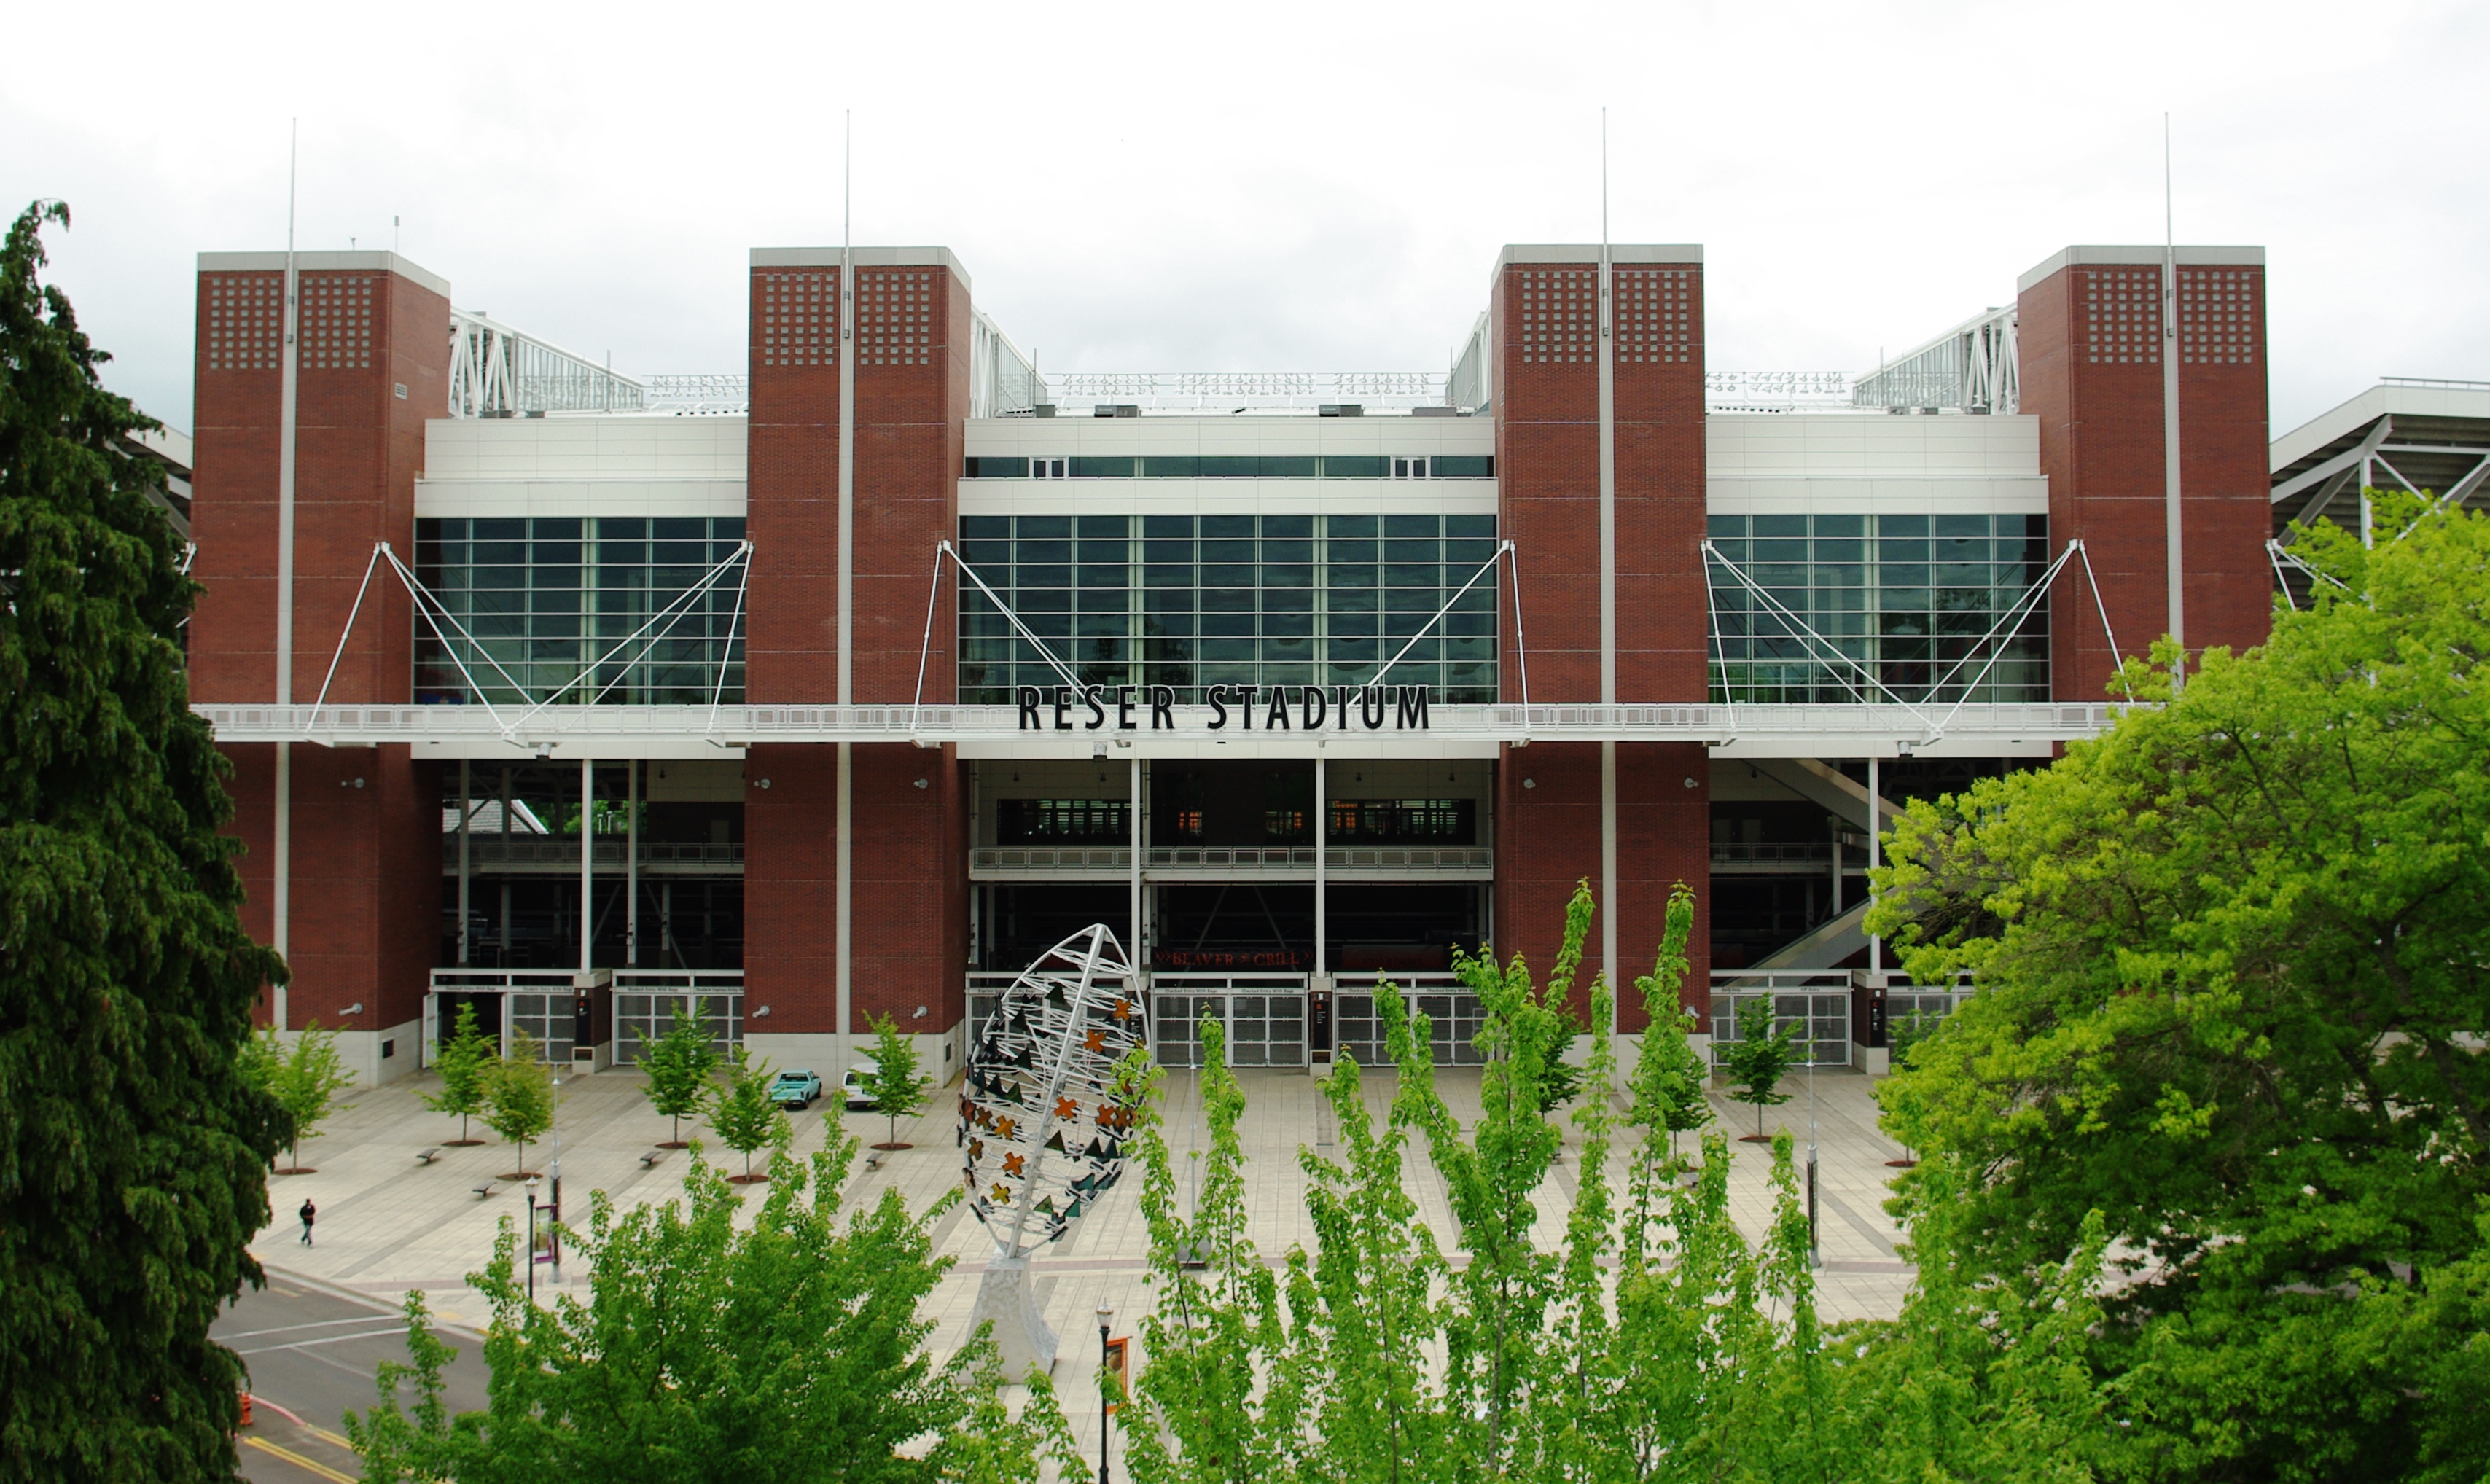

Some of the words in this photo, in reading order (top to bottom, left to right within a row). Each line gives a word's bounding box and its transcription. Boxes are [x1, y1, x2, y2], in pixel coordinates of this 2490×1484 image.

[1018, 684, 1175, 730] RESER
[1206, 684, 1429, 730] STADIUM
[1171, 951, 1234, 966] BEAVER
